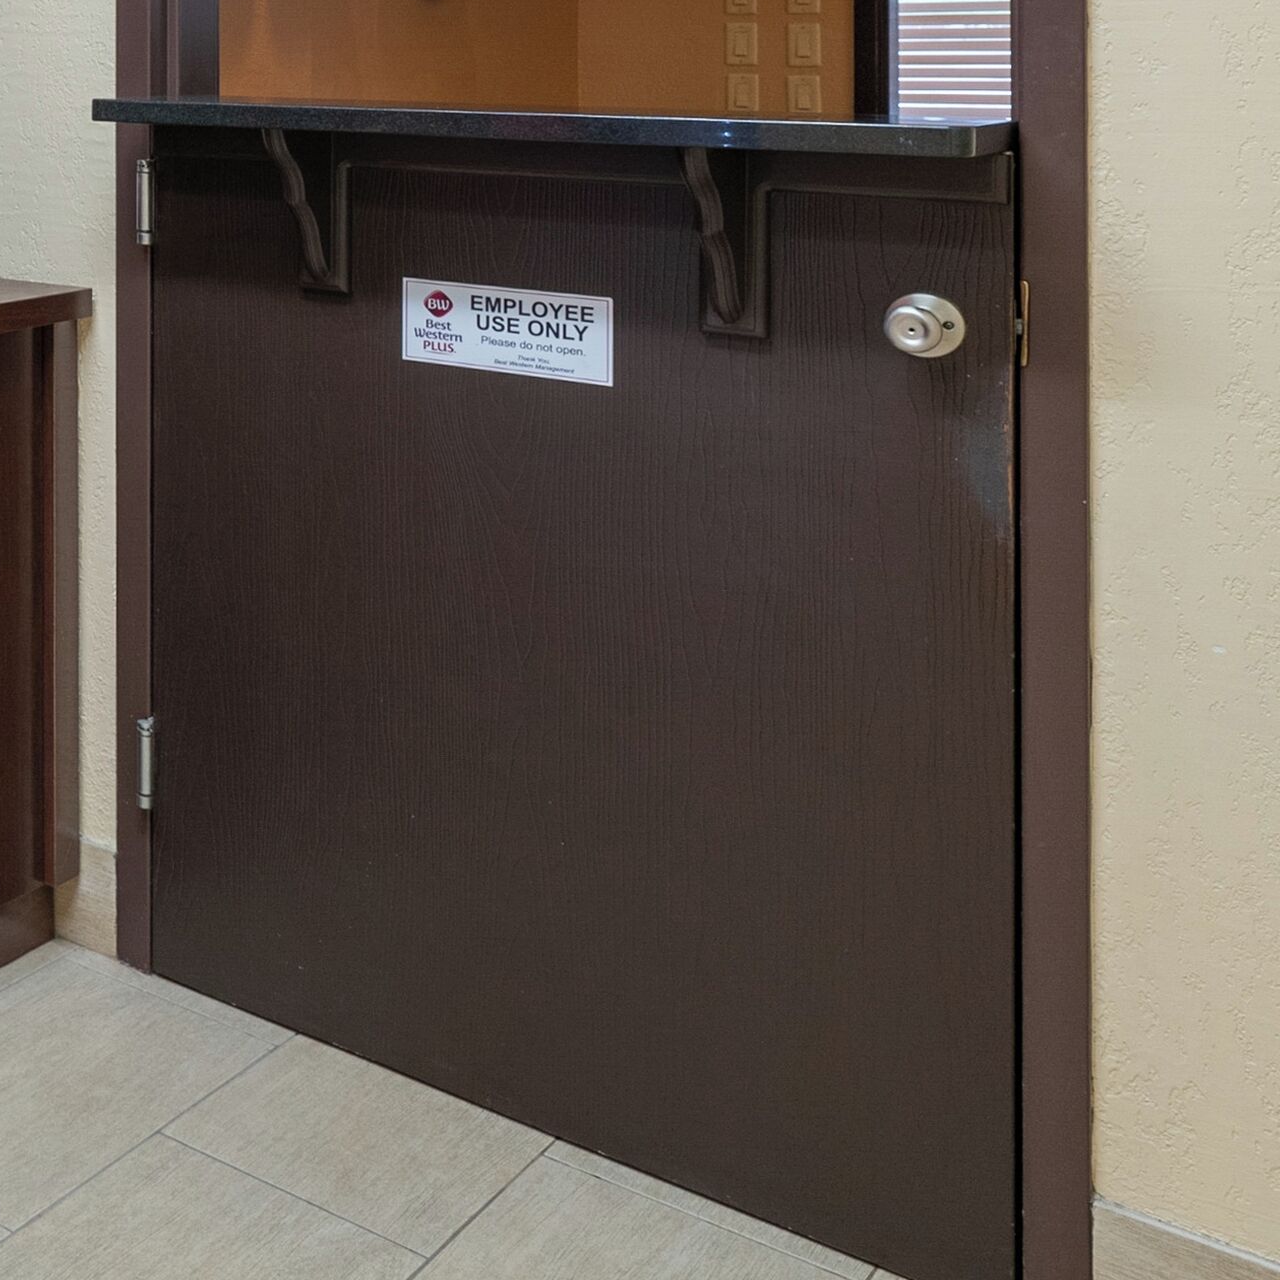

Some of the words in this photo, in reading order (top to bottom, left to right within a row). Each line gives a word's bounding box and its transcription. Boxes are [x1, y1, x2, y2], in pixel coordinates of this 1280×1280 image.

[426, 298, 449, 311] BW
[470, 294, 595, 323] EMPLOYEE
[425, 318, 451, 331] Best
[476, 314, 520, 334] USE
[527, 320, 589, 342] ONLY
[414, 327, 463, 343] Western
[423, 340, 454, 353] PLUS
[480, 335, 517, 350] Please
[519, 340, 533, 351] do
[535, 342, 553, 353] not
[555, 345, 587, 357] open.
[518, 354, 536, 362] Thank
[509, 360, 534, 368] Western
[534, 363, 575, 374] Management
